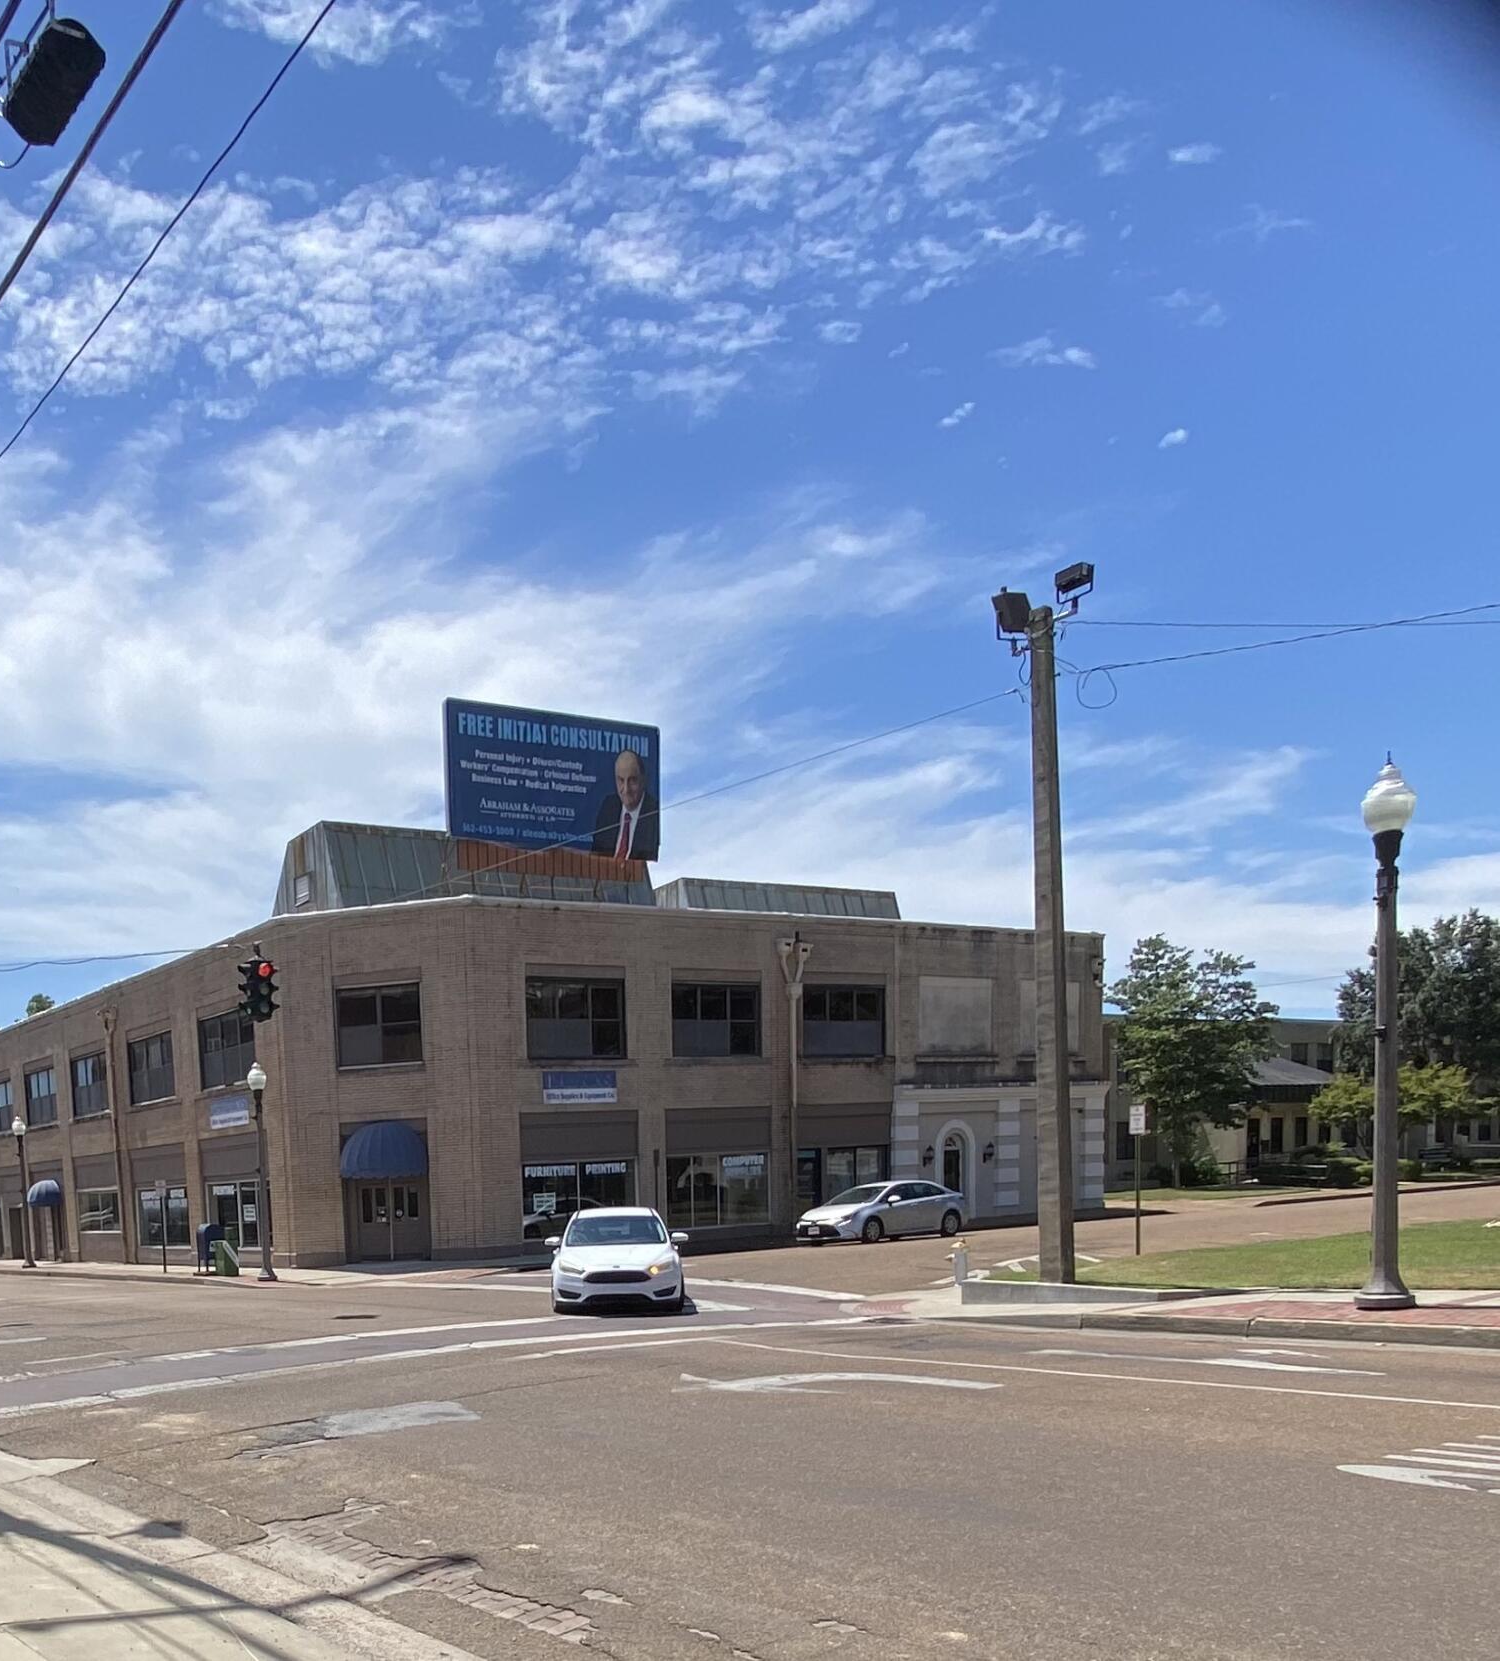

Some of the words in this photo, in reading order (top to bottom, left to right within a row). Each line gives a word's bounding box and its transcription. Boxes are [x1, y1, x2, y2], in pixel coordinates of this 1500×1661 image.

[458, 712, 493, 738] FREE
[498, 718, 547, 744] INITIAL
[551, 724, 648, 757] CONSULTATION
[475, 749, 504, 761] Personal
[506, 753, 525, 765] Injury
[492, 764, 538, 777] Compensation
[544, 770, 569, 781] Criminal
[571, 772, 596, 783] Defense
[472, 773, 502, 785] Business
[504, 776, 517, 786] Law
[525, 779, 550, 790] Medical
[551, 781, 587, 794] Malpractice
[522, 800, 531, 811] &
[722, 1154, 765, 1167] COMPUTER
[524, 1164, 576, 1178] FURNITURE
[585, 1162, 627, 1176] PRINTING
